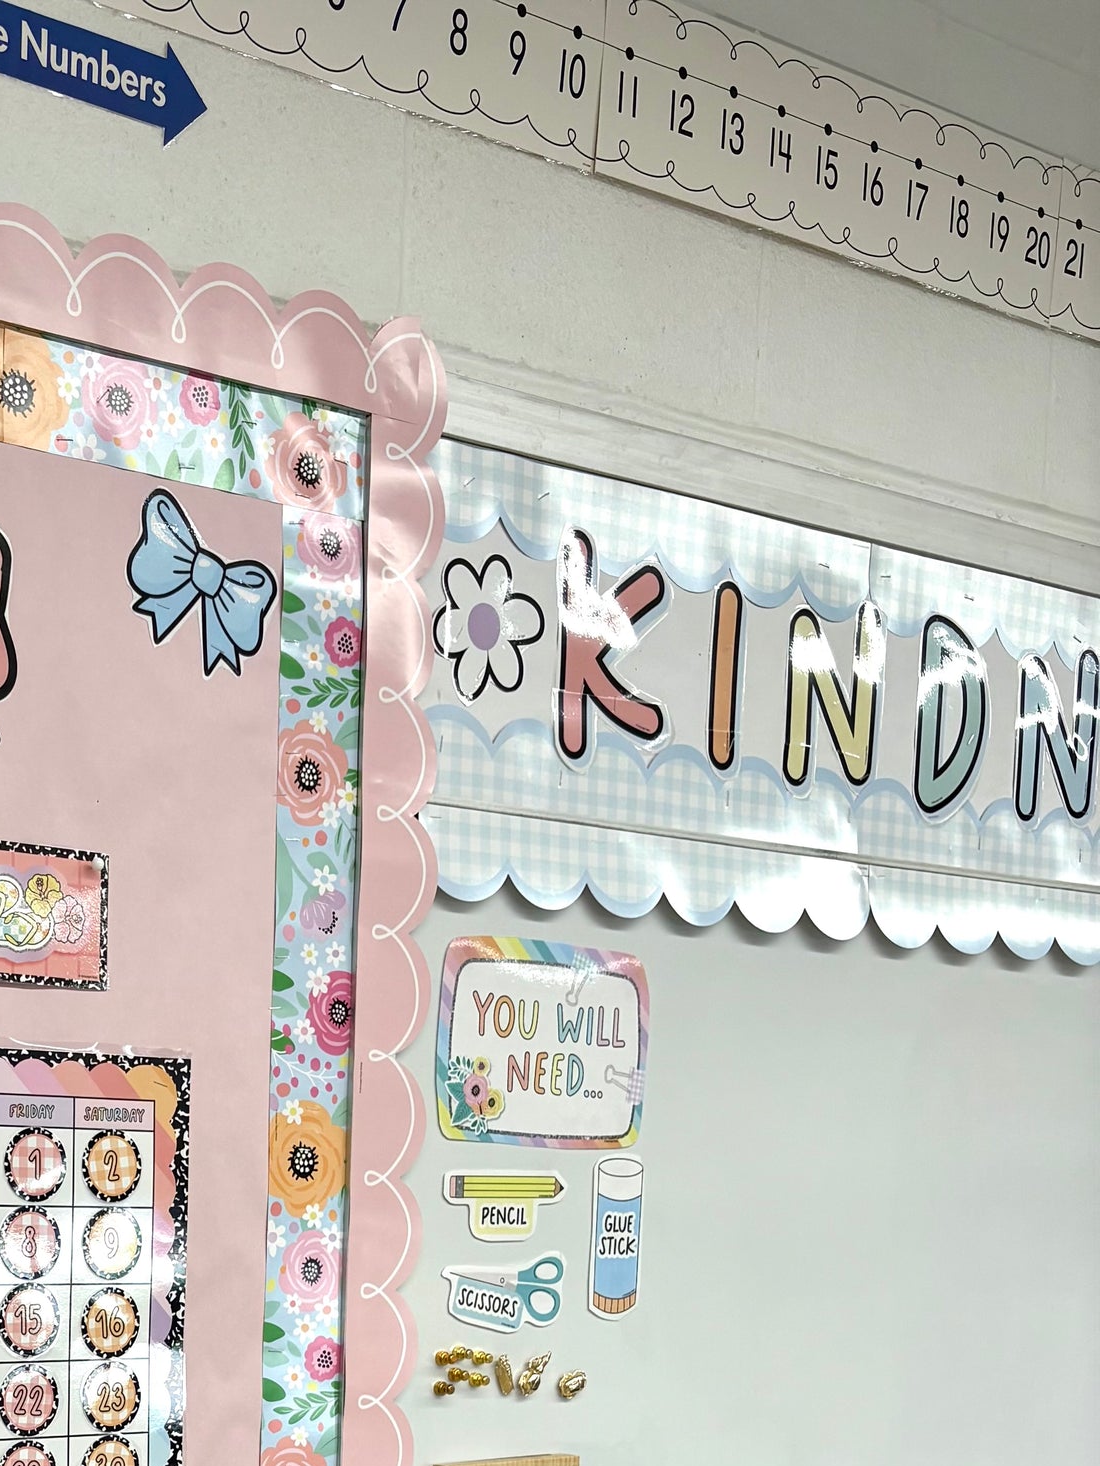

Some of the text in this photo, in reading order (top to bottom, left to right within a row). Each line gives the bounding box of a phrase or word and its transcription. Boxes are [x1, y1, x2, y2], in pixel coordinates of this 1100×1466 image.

[21, 20, 167, 107] Numbers
[450, 9, 468, 55] 8
[510, 31, 526, 75] 9
[559, 49, 586, 98] 10
[618, 71, 638, 118] 11
[669, 90, 695, 137] 12
[721, 109, 745, 154] 13
[770, 127, 792, 172] 14
[816, 146, 838, 190] 15
[863, 163, 884, 206] 16
[907, 179, 929, 220] 17
[949, 196, 969, 237] 18
[990, 212, 1010, 252] 19
[1025, 226, 1050, 268] 20
[1064, 239, 1085, 278] 21
[473, 990, 626, 1048] YOU WILL
[9, 1104, 55, 1119] FRIDAY
[84, 1107, 145, 1123] SATURDAY
[29, 1148, 119, 1181] 1 2
[481, 1206, 527, 1226] PENCIL
[604, 1214, 634, 1233] GLUE
[21, 1226, 37, 1258] 8
[103, 1227, 119, 1259] 9
[599, 1236, 636, 1255] STICK
[458, 1288, 518, 1318] SCISSORS
[14, 1304, 42, 1336] 15
[95, 1308, 125, 1338] 16
[13, 1384, 44, 1417] 22
[98, 1382, 125, 1412] 23
